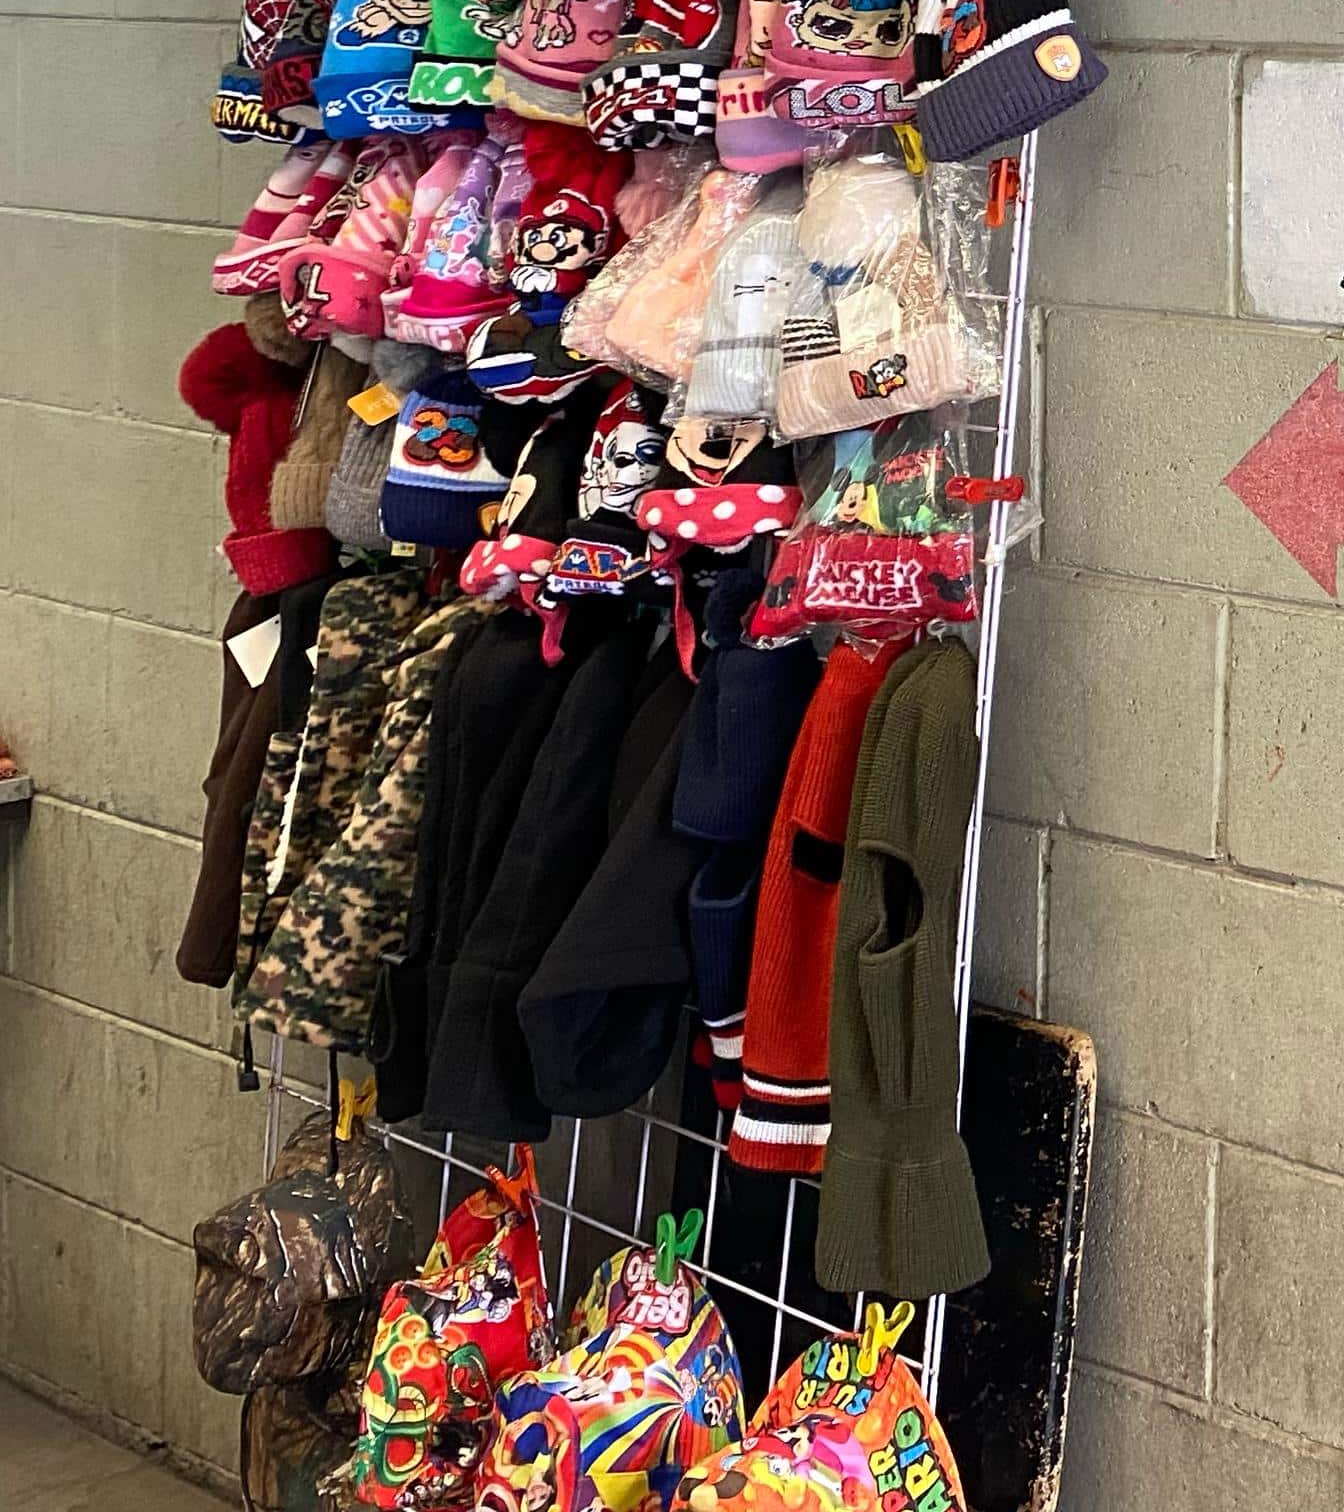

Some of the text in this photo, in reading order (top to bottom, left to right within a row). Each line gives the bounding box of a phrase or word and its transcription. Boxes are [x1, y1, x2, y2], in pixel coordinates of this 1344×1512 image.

[806, 556, 922, 588] MICKEY
[868, 1443, 909, 1512] PER
[893, 1407, 953, 1512] ARIO
